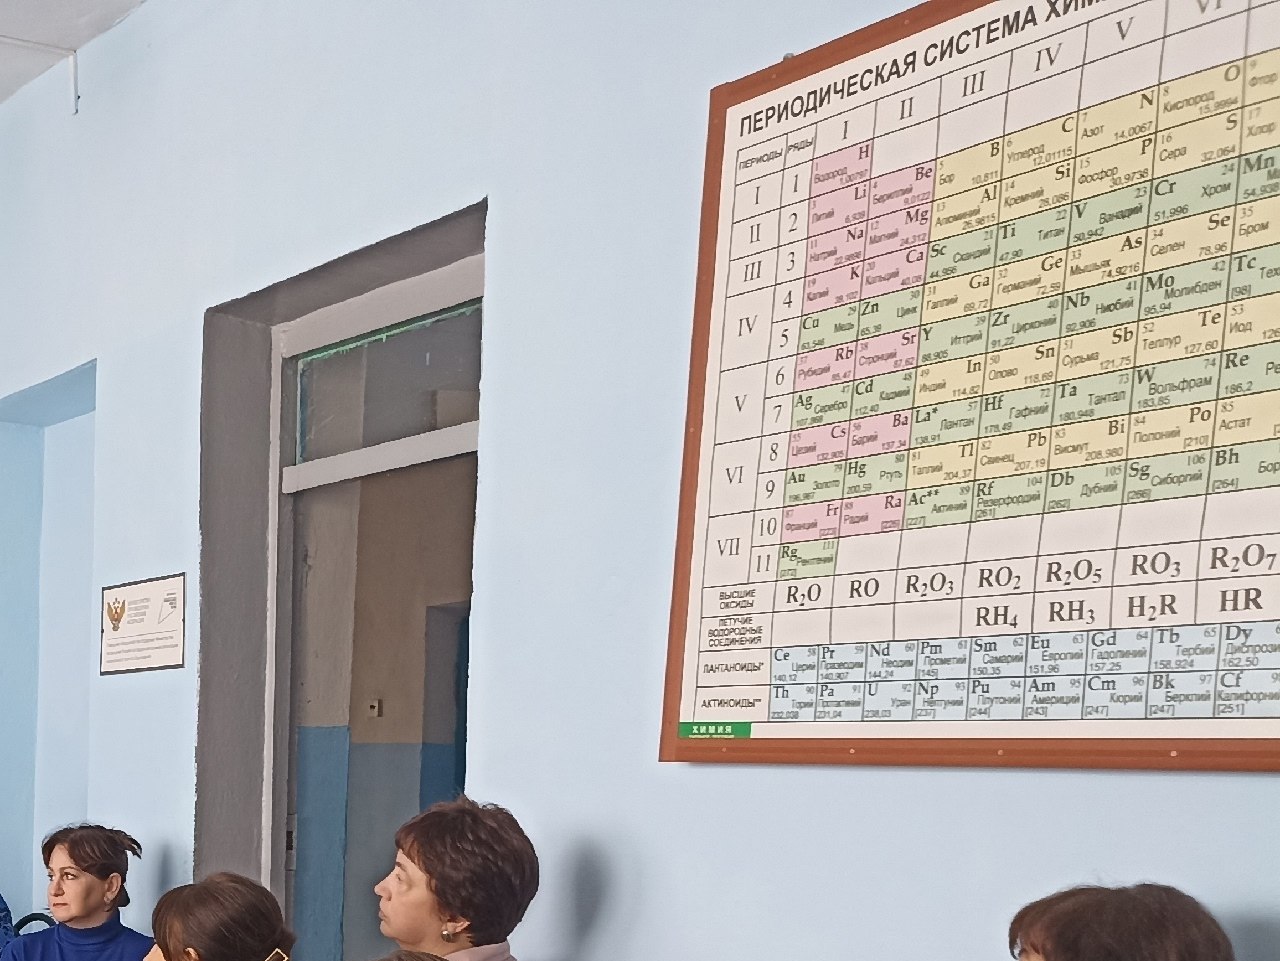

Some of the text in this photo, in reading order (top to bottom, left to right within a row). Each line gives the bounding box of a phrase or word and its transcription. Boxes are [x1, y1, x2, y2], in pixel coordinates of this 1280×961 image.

[739, 51, 917, 137] ПЕРИОДИЧЕСКАЯ
[923, 6, 1038, 66] СИСТЕМА
[899, 96, 915, 121] II
[961, 70, 986, 97] III
[1035, 43, 1063, 72] IV
[1116, 17, 1134, 41] V
[1224, 64, 1240, 82] O
[1140, 91, 1155, 109] N
[1062, 117, 1074, 133] C
[1225, 113, 1238, 130] S
[1081, 125, 1104, 139] Азот
[739, 137, 814, 170] ПЕРИОДЫ РЯДЫ
[859, 144, 870, 160] H
[990, 142, 1000, 157] B
[1141, 138, 1152, 155] P
[1055, 163, 1071, 181] Si
[1242, 154, 1275, 174] Mn
[915, 166, 933, 181] Be
[854, 184, 867, 200] Li
[981, 185, 997, 203] Al
[1155, 180, 1176, 196] Cr
[905, 209, 929, 225] Mg
[1074, 204, 1087, 219] V
[788, 213, 797, 232] 2
[1207, 214, 1231, 231] Se
[750, 223, 761, 244] II
[846, 228, 864, 242] Na
[1000, 224, 1016, 239] Ti
[930, 244, 947, 257] Sc
[1121, 235, 1143, 252] As
[786, 252, 795, 271] 3
[906, 250, 924, 264] Ca
[1041, 256, 1063, 272] Ge
[1234, 256, 1256, 272] Tc
[744, 261, 762, 281] III
[850, 266, 860, 280] K
[969, 275, 990, 289] Ga
[1145, 274, 1175, 292] Mo
[783, 290, 793, 308] 4
[1065, 292, 1090, 310] Nb
[862, 302, 879, 315] Zn
[738, 315, 757, 337] IV
[992, 313, 1010, 327] Zr
[1198, 311, 1221, 327] Te
[779, 329, 789, 347] 5
[901, 331, 916, 346] Sr
[923, 327, 933, 341] Y
[1112, 328, 1134, 344] Sb
[835, 348, 853, 361] Rb
[1034, 346, 1055, 360] Sn
[1224, 352, 1249, 369] Re
[966, 359, 981, 374] In
[775, 367, 784, 385] 6
[1136, 367, 1156, 385] W
[855, 380, 873, 395] Cd
[1058, 383, 1077, 398] Ta
[1148, 376, 1213, 395] Вольфрам
[734, 395, 747, 412] V
[795, 394, 813, 410] Ag
[984, 395, 1004, 412] Hf
[773, 405, 782, 423] 7
[893, 414, 909, 427] Ba
[1189, 407, 1212, 423] Po
[831, 426, 846, 439] Cs
[1108, 419, 1125, 435] Bi
[1028, 432, 1047, 448] Pb
[769, 443, 778, 461] 8
[1215, 449, 1239, 466] Bh
[726, 466, 744, 485] VI
[787, 471, 805, 484] Au
[848, 461, 867, 478] Hg
[1128, 462, 1150, 481] Sg
[1051, 471, 1074, 488] Db
[766, 480, 775, 499] 9
[977, 481, 994, 498] Rf
[826, 504, 839, 517] Fr
[884, 495, 902, 510] Ra
[760, 518, 777, 536] 10
[718, 538, 740, 556] VII
[781, 545, 798, 562] Rg
[756, 555, 770, 572] 11
[1131, 551, 1181, 577] RO3
[1210, 543, 1277, 573] R2O7
[978, 566, 1021, 590] RO2
[1045, 559, 1102, 586] R2O5
[849, 578, 880, 599] RO
[905, 572, 954, 597] R2O3
[720, 589, 756, 600] ВЫСШИЕ
[787, 583, 821, 606] R2O
[1220, 588, 1263, 612] HR
[720, 600, 754, 609] ОКСИДЫ
[1128, 594, 1178, 621] H2R
[976, 605, 1018, 628] RH4
[1049, 601, 1095, 625] RH3
[708, 627, 763, 637] ВОДОРОДНЫЕ
[1091, 632, 1117, 647] Gd
[1156, 628, 1180, 643] Tb
[1225, 625, 1253, 644] Dy
[709, 636, 762, 647] СОЕДИНЕНИЯ
[921, 642, 942, 654] Pm
[974, 639, 998, 652] Sm
[1031, 636, 1050, 649] Eu
[774, 649, 790, 661] Ce
[822, 647, 835, 659] Pr
[870, 644, 890, 657] Nd
[971, 680, 990, 693] Pu
[1028, 679, 1056, 692] Am
[1088, 676, 1116, 690] Cm
[1152, 675, 1175, 690] Bk
[1221, 671, 1243, 688] Cf
[773, 686, 789, 698] Th
[820, 685, 834, 697] Pa
[868, 684, 879, 696] U
[917, 682, 939, 699] Np
[692, 725, 732, 734] ХИМИЯ
